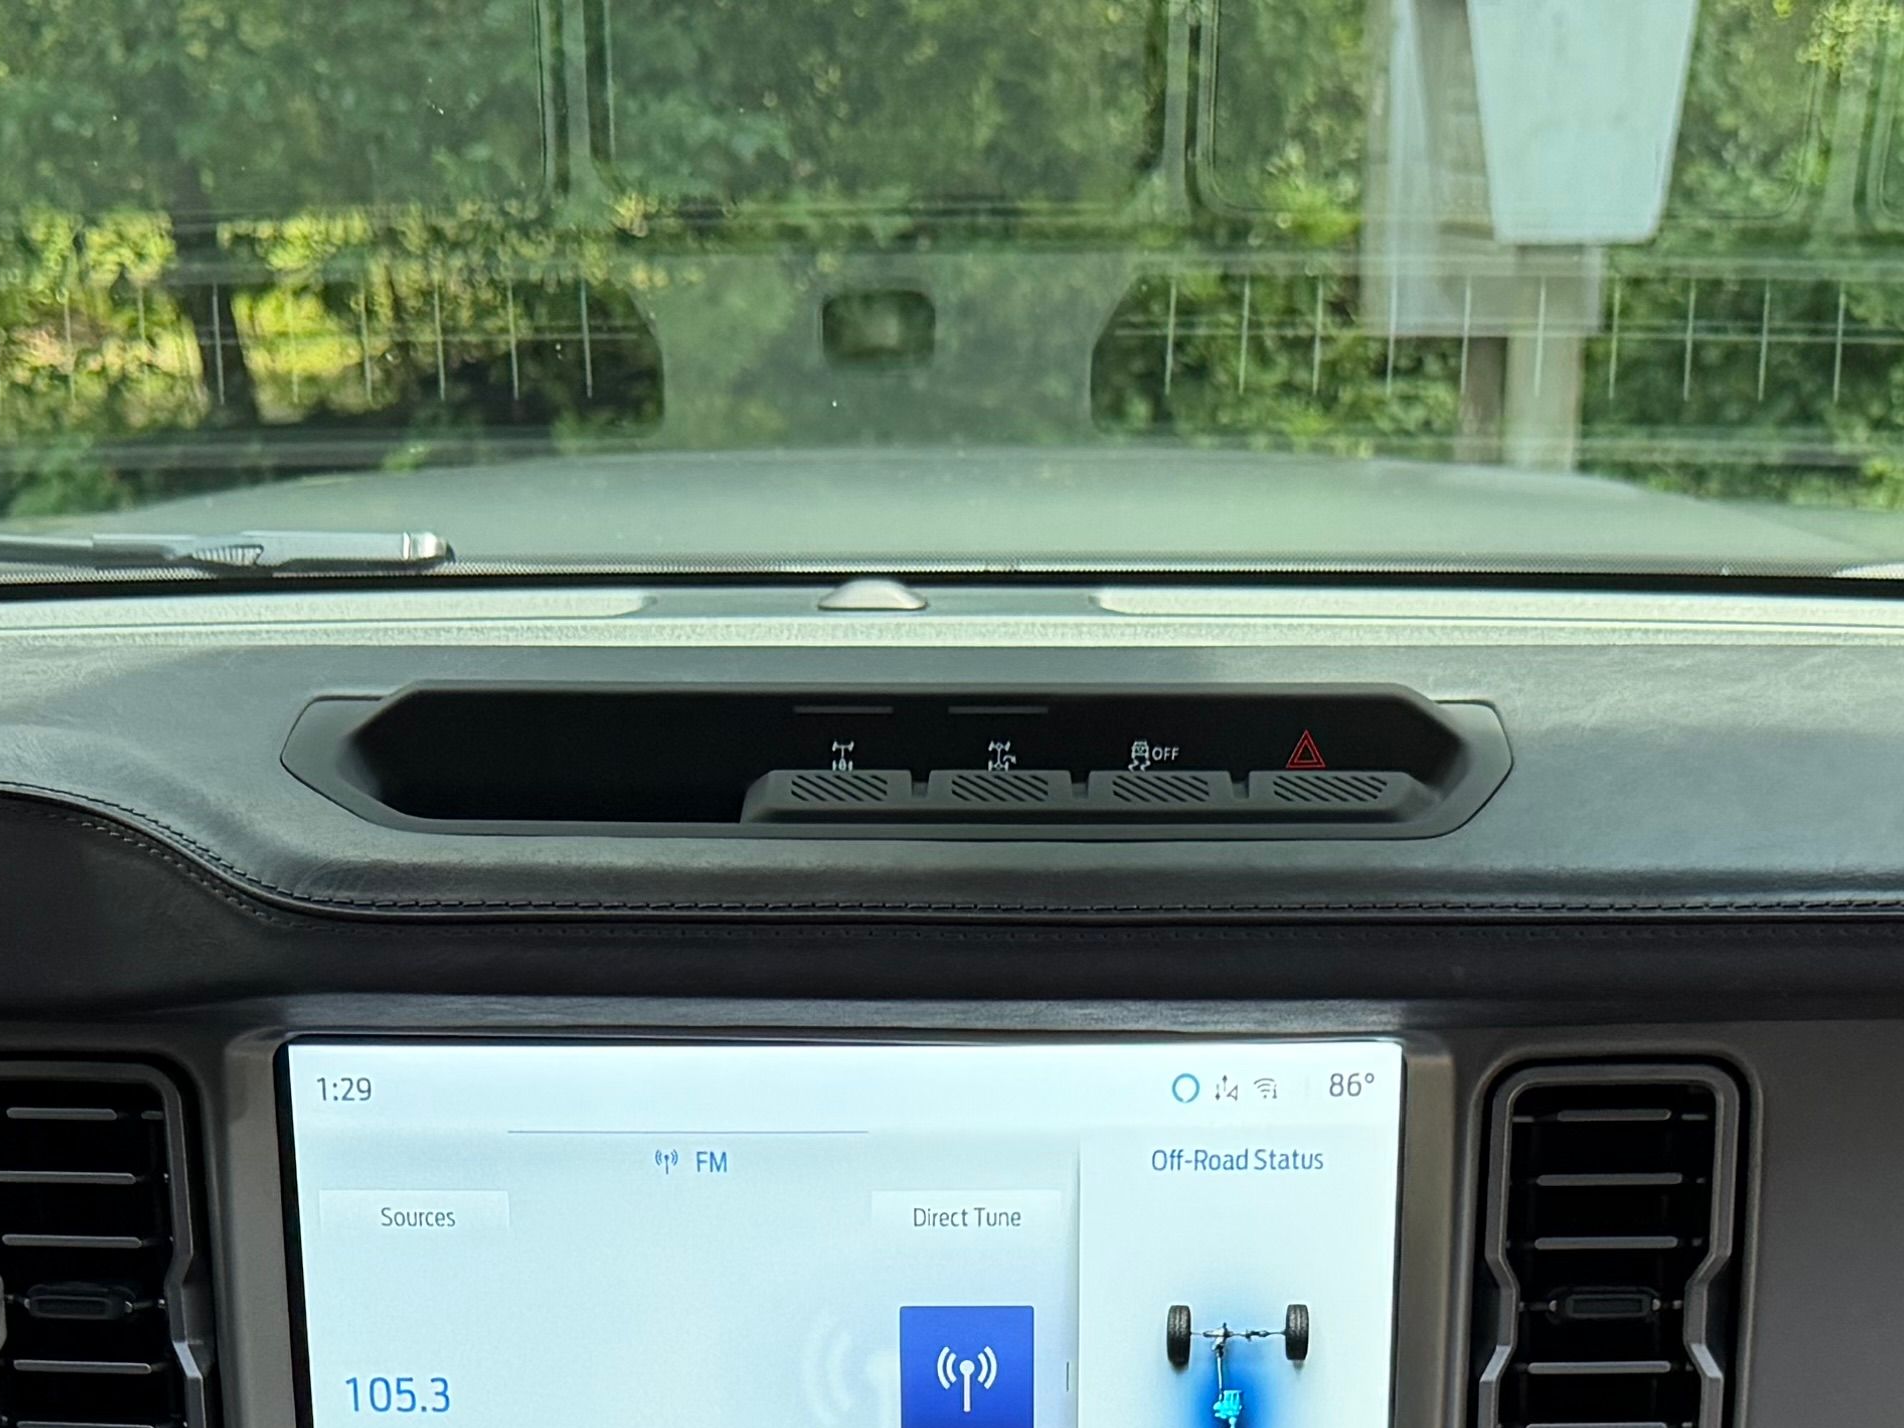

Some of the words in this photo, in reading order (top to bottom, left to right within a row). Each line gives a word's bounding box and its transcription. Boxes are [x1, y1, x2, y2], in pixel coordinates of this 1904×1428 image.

[1151, 746, 1180, 761] OFF
[316, 1077, 372, 1101] 1:29
[1329, 1072, 1376, 1097] 86°
[696, 1151, 728, 1173] FM
[1152, 1149, 1249, 1171] Off-Road
[1253, 1148, 1324, 1171] Status
[380, 1206, 456, 1227] Sources
[912, 1207, 968, 1228] Direct
[974, 1207, 1022, 1228] Tune
[346, 1377, 451, 1412] 105.3
